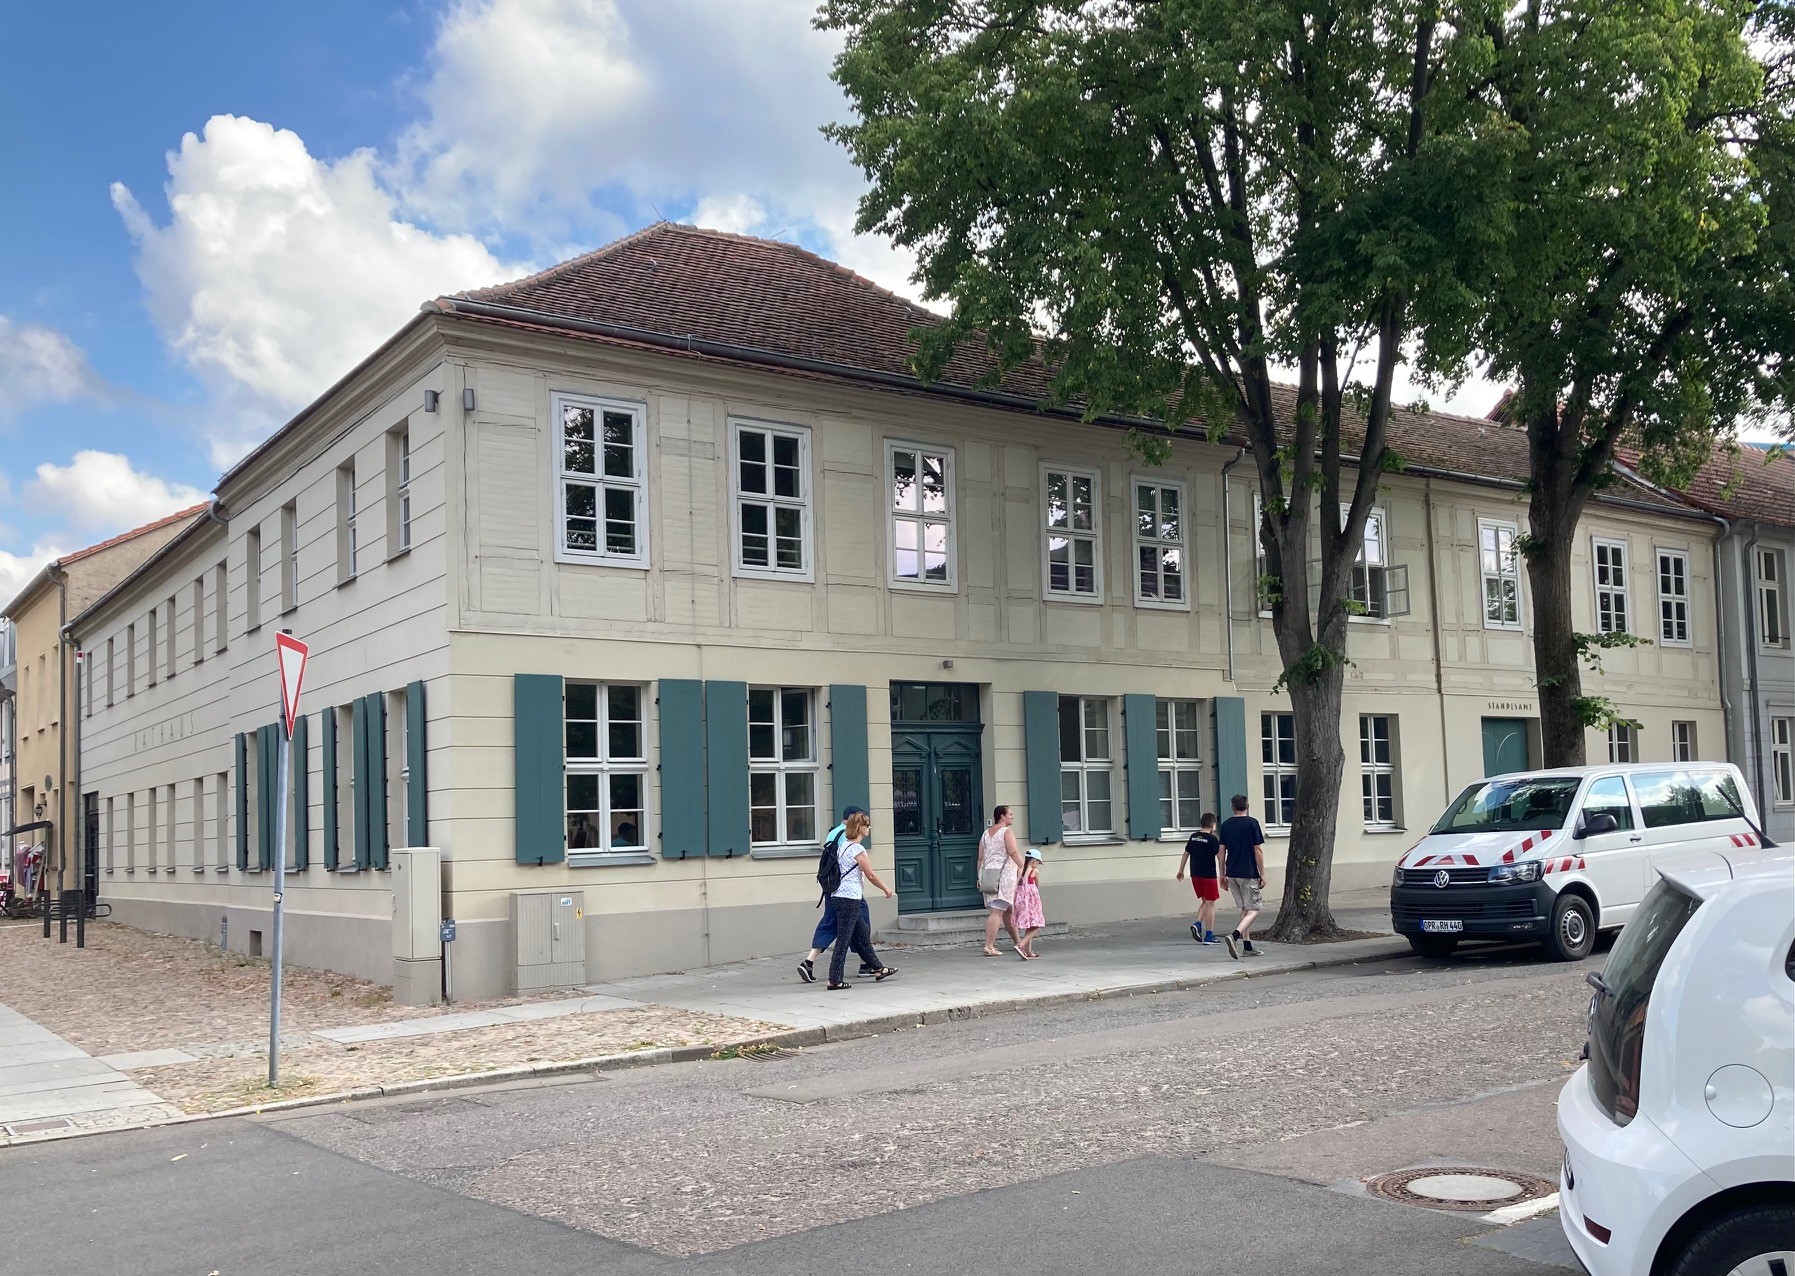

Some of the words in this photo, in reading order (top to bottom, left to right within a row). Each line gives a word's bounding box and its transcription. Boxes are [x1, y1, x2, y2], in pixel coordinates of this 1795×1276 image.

[1488, 702, 1532, 710] STANDESAMT
[133, 712, 194, 751] RATHAUS
[1423, 920, 1436, 930] OPR
[1450, 921, 1462, 930] 440
